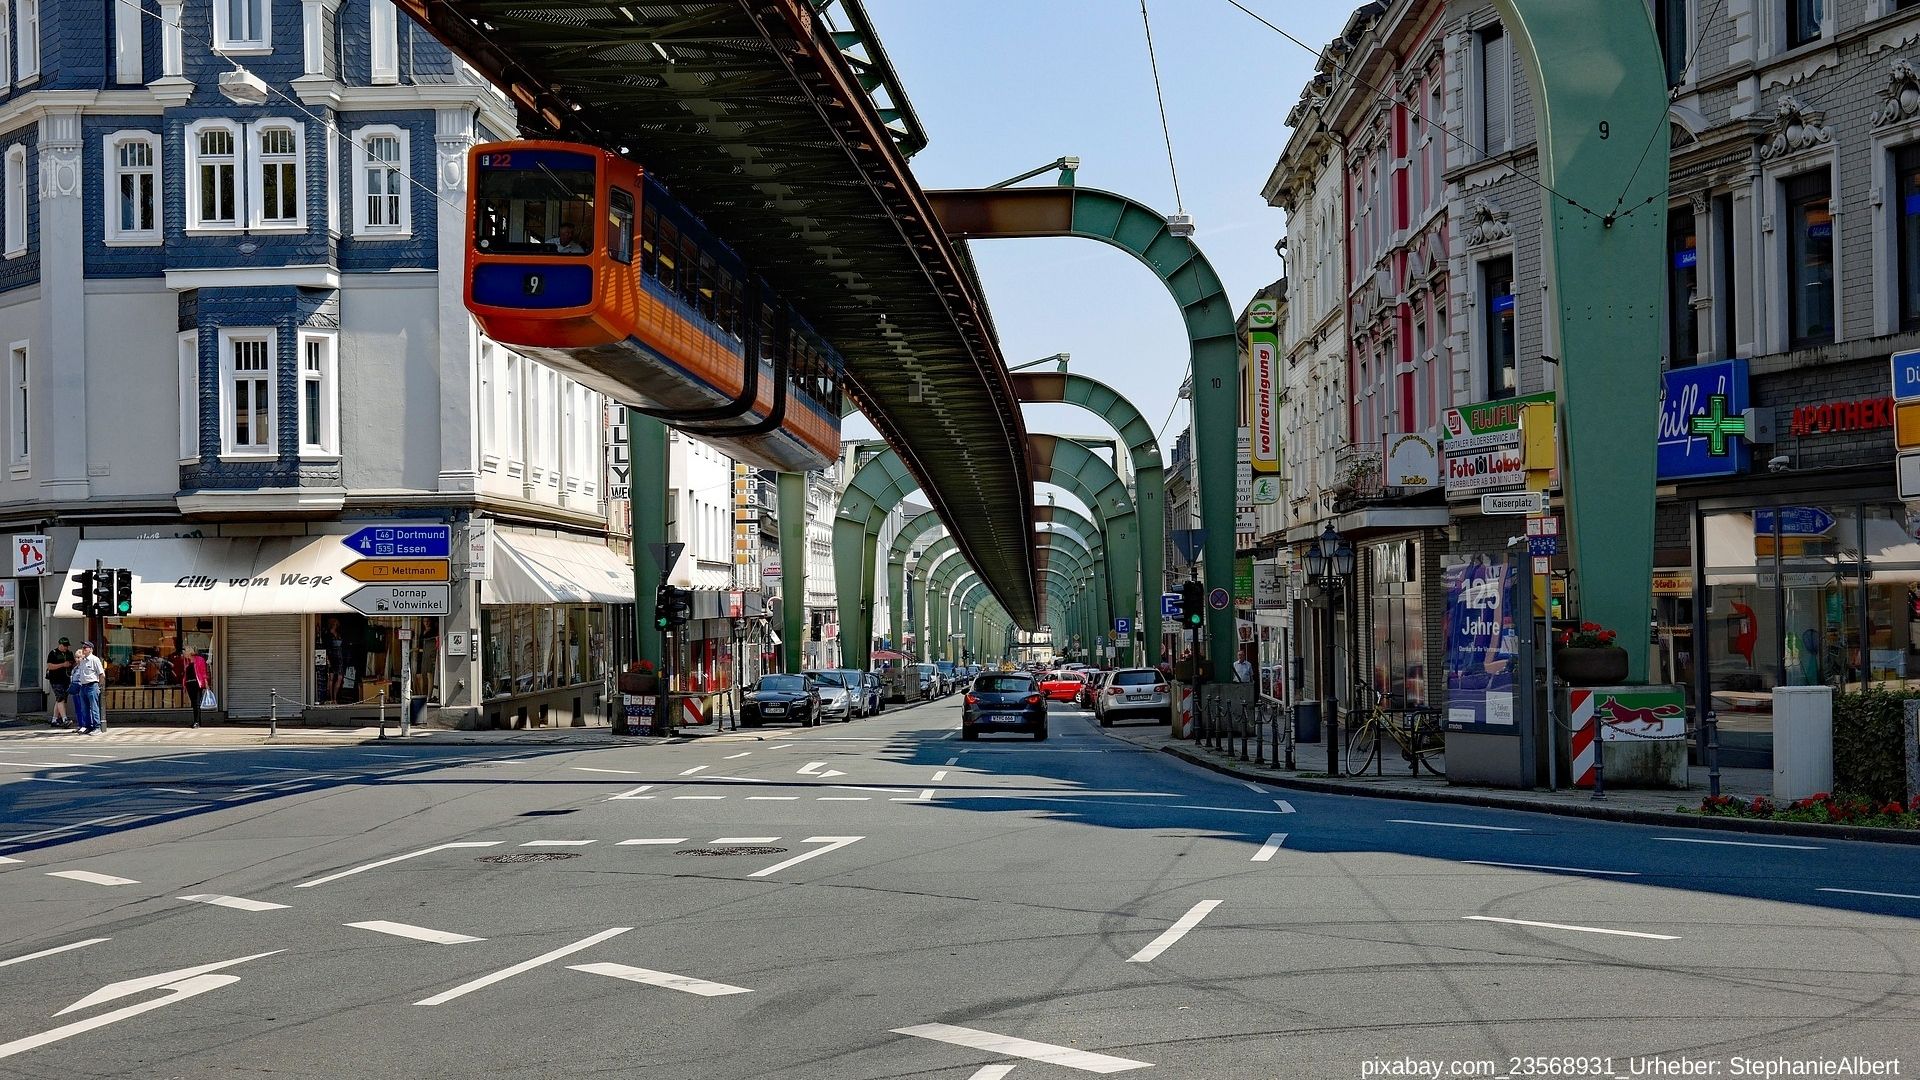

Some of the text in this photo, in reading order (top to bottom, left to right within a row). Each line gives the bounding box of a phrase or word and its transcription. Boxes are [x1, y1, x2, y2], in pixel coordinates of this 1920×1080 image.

[1598, 120, 1610, 140] 9
[492, 153, 512, 167] 22
[530, 276, 539, 293] 9
[1211, 377, 1222, 389] 10
[1258, 349, 1271, 454] vollreinigung
[1471, 402, 1521, 430] FUJIFIL
[1791, 396, 1895, 438] APOTHEK
[612, 400, 630, 484] ILLY
[1445, 438, 1469, 450] DIGITALER
[1469, 433, 1509, 447] BILDERSERVICE
[1449, 452, 1520, 479] Foto Lobo
[1449, 477, 1480, 489] FARBBILDER
[1489, 476, 1497, 484] 30
[1492, 499, 1532, 509] Kaiserplatz
[380, 530, 445, 539] 46 Dortmund
[378, 545, 427, 553] 535 Essen
[392, 566, 436, 575] Mettmann
[174, 573, 333, 591] Lilly vom Wege
[392, 589, 427, 599] Dornap
[1461, 578, 1500, 610] 125
[393, 600, 443, 609] Vohwinkel
[1461, 616, 1500, 636] Jahre
